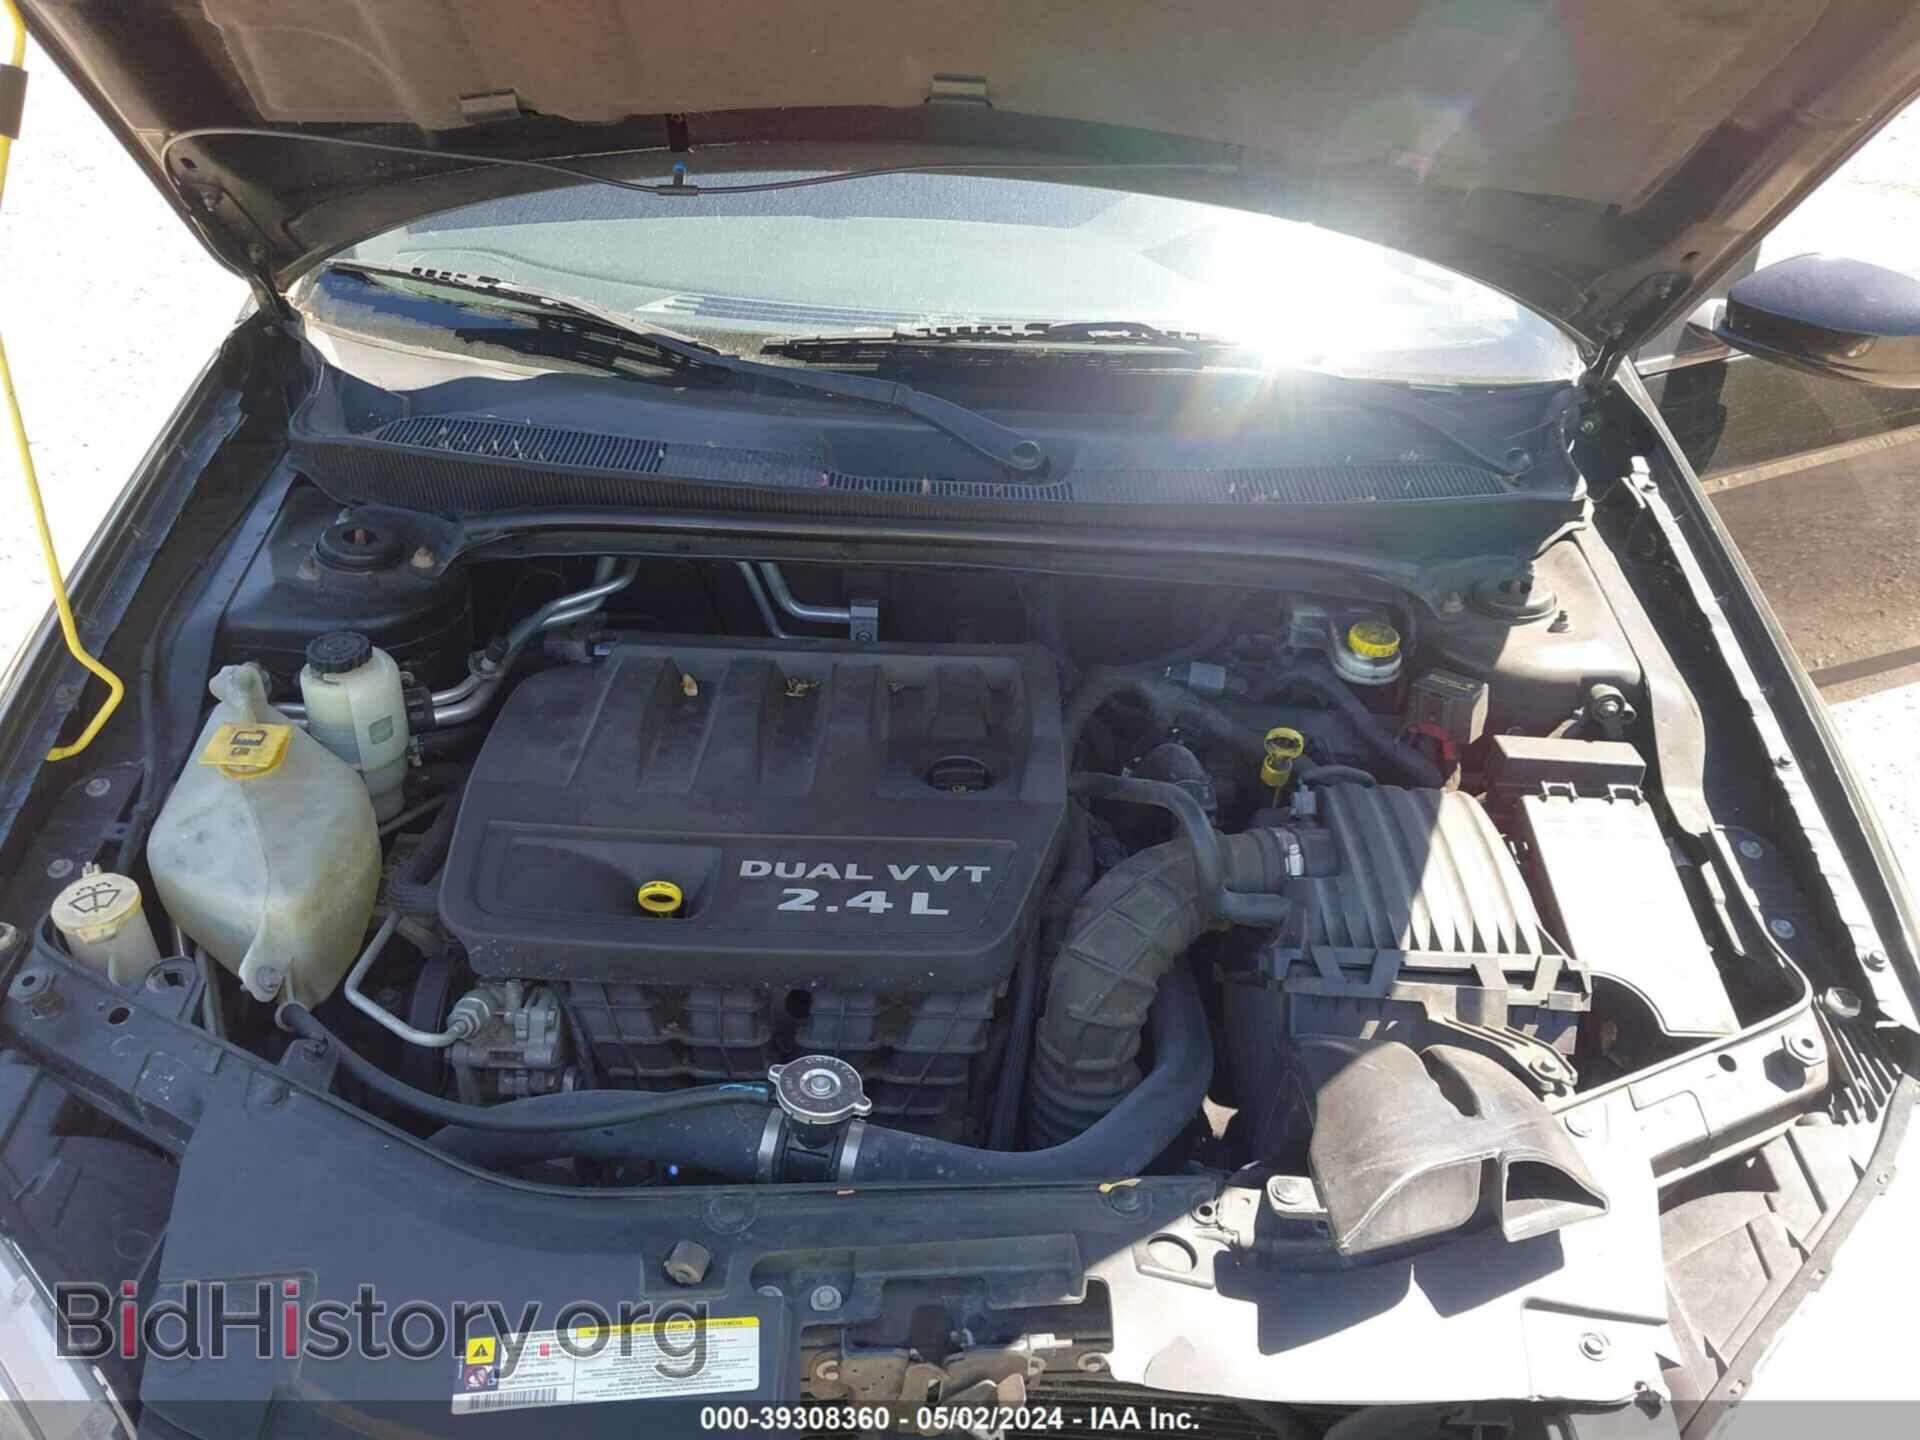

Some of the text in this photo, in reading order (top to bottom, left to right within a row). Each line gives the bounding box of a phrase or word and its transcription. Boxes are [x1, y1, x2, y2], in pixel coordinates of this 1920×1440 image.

[739, 860, 991, 883] DUAL VVT
[777, 888, 949, 915] 2.4 L
